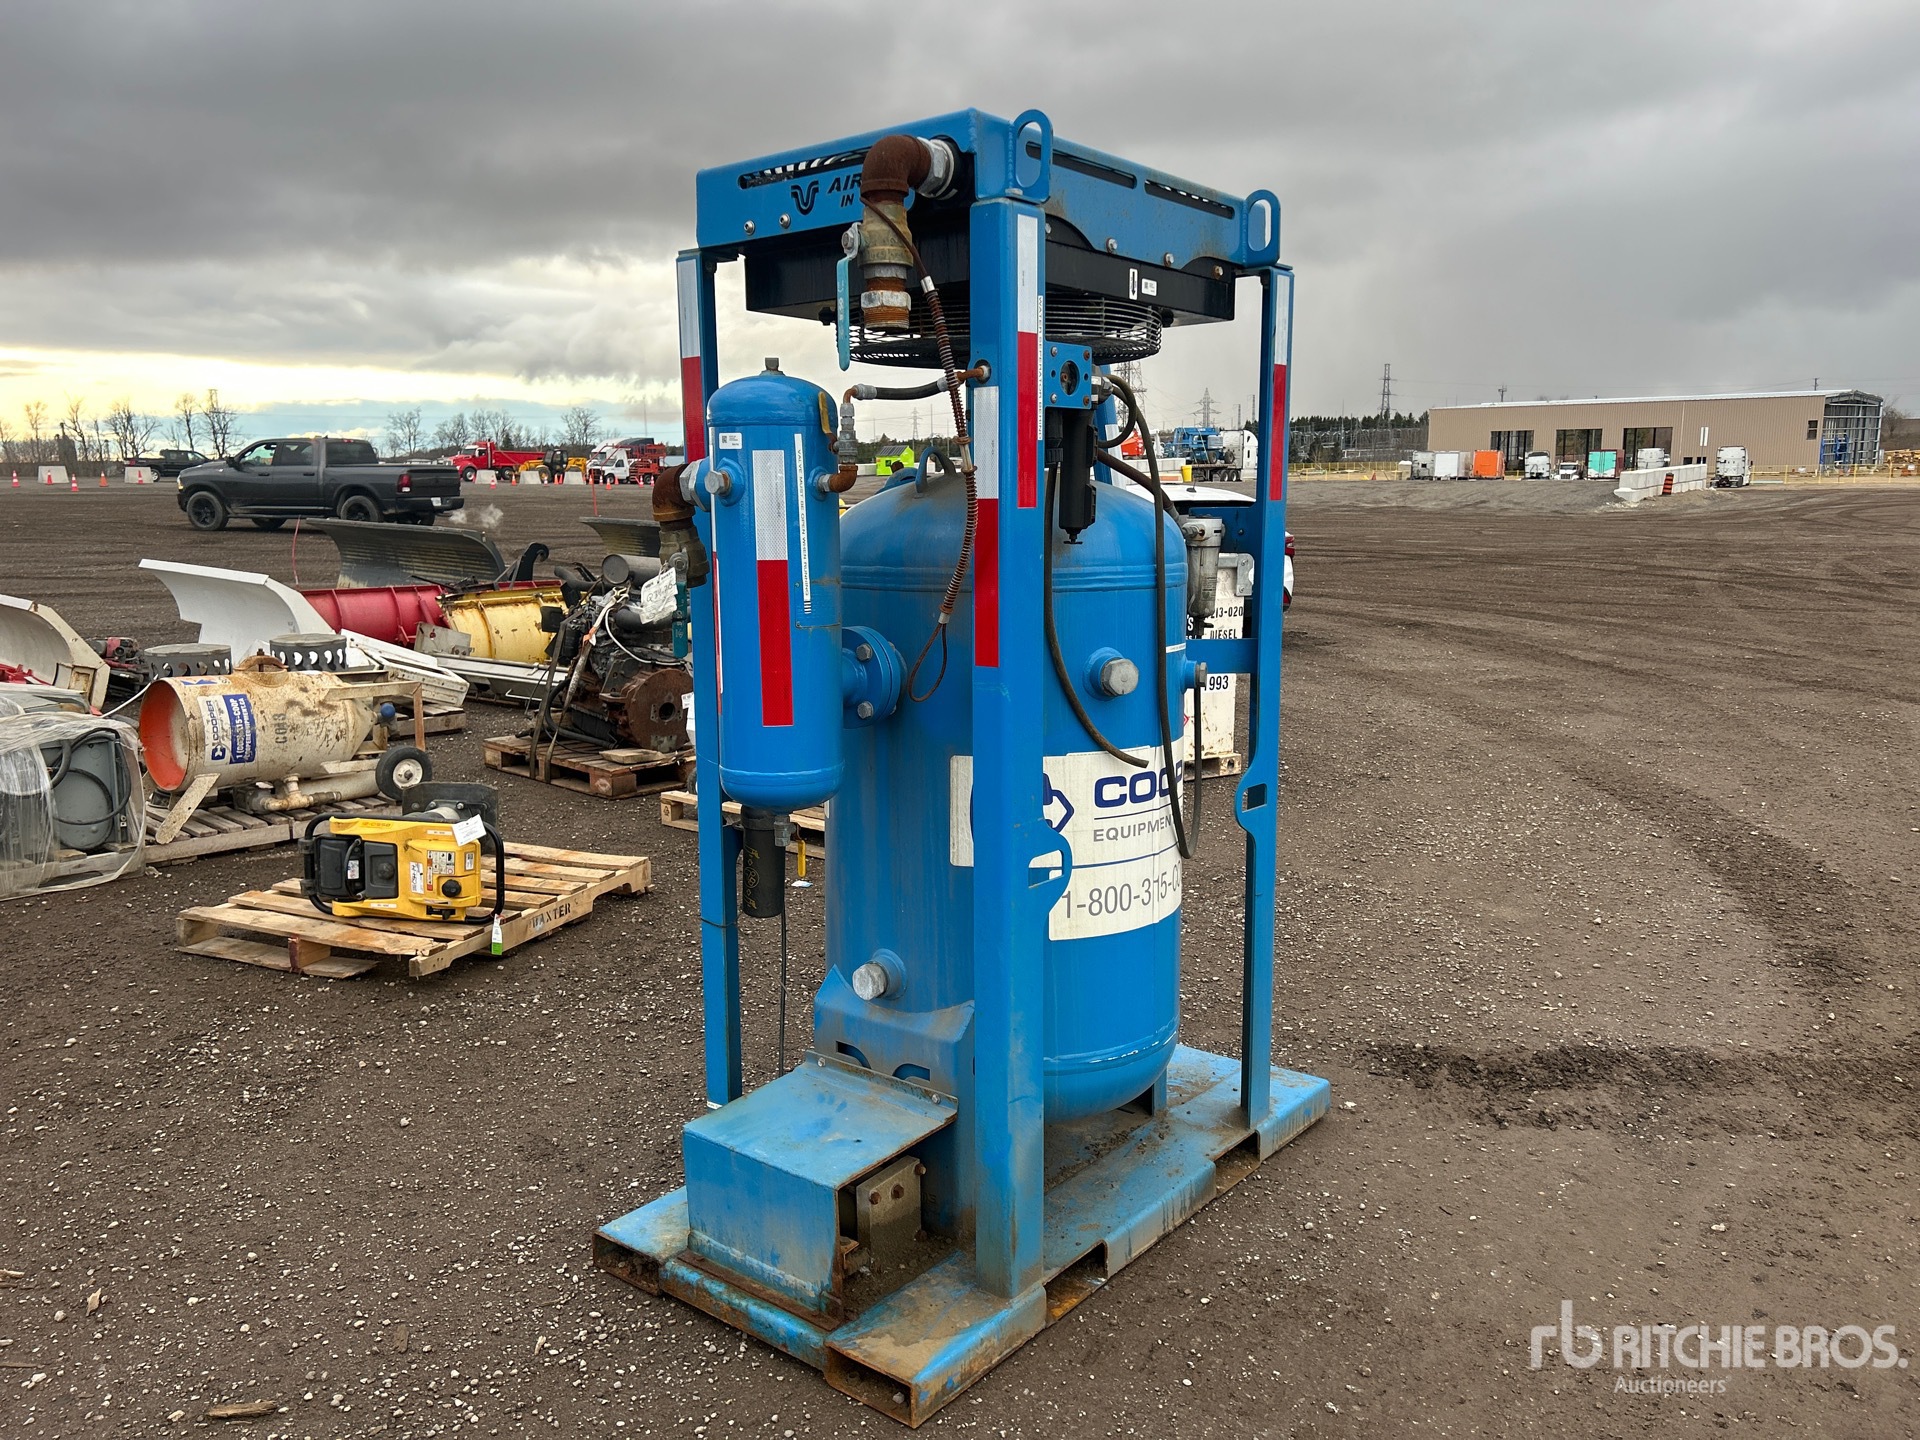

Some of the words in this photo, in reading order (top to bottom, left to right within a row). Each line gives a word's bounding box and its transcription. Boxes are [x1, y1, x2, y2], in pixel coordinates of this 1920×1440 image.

[840, 193, 855, 208] IN
[206, 700, 219, 741] COOPER
[1093, 814, 1173, 843] EQUIPMEN
